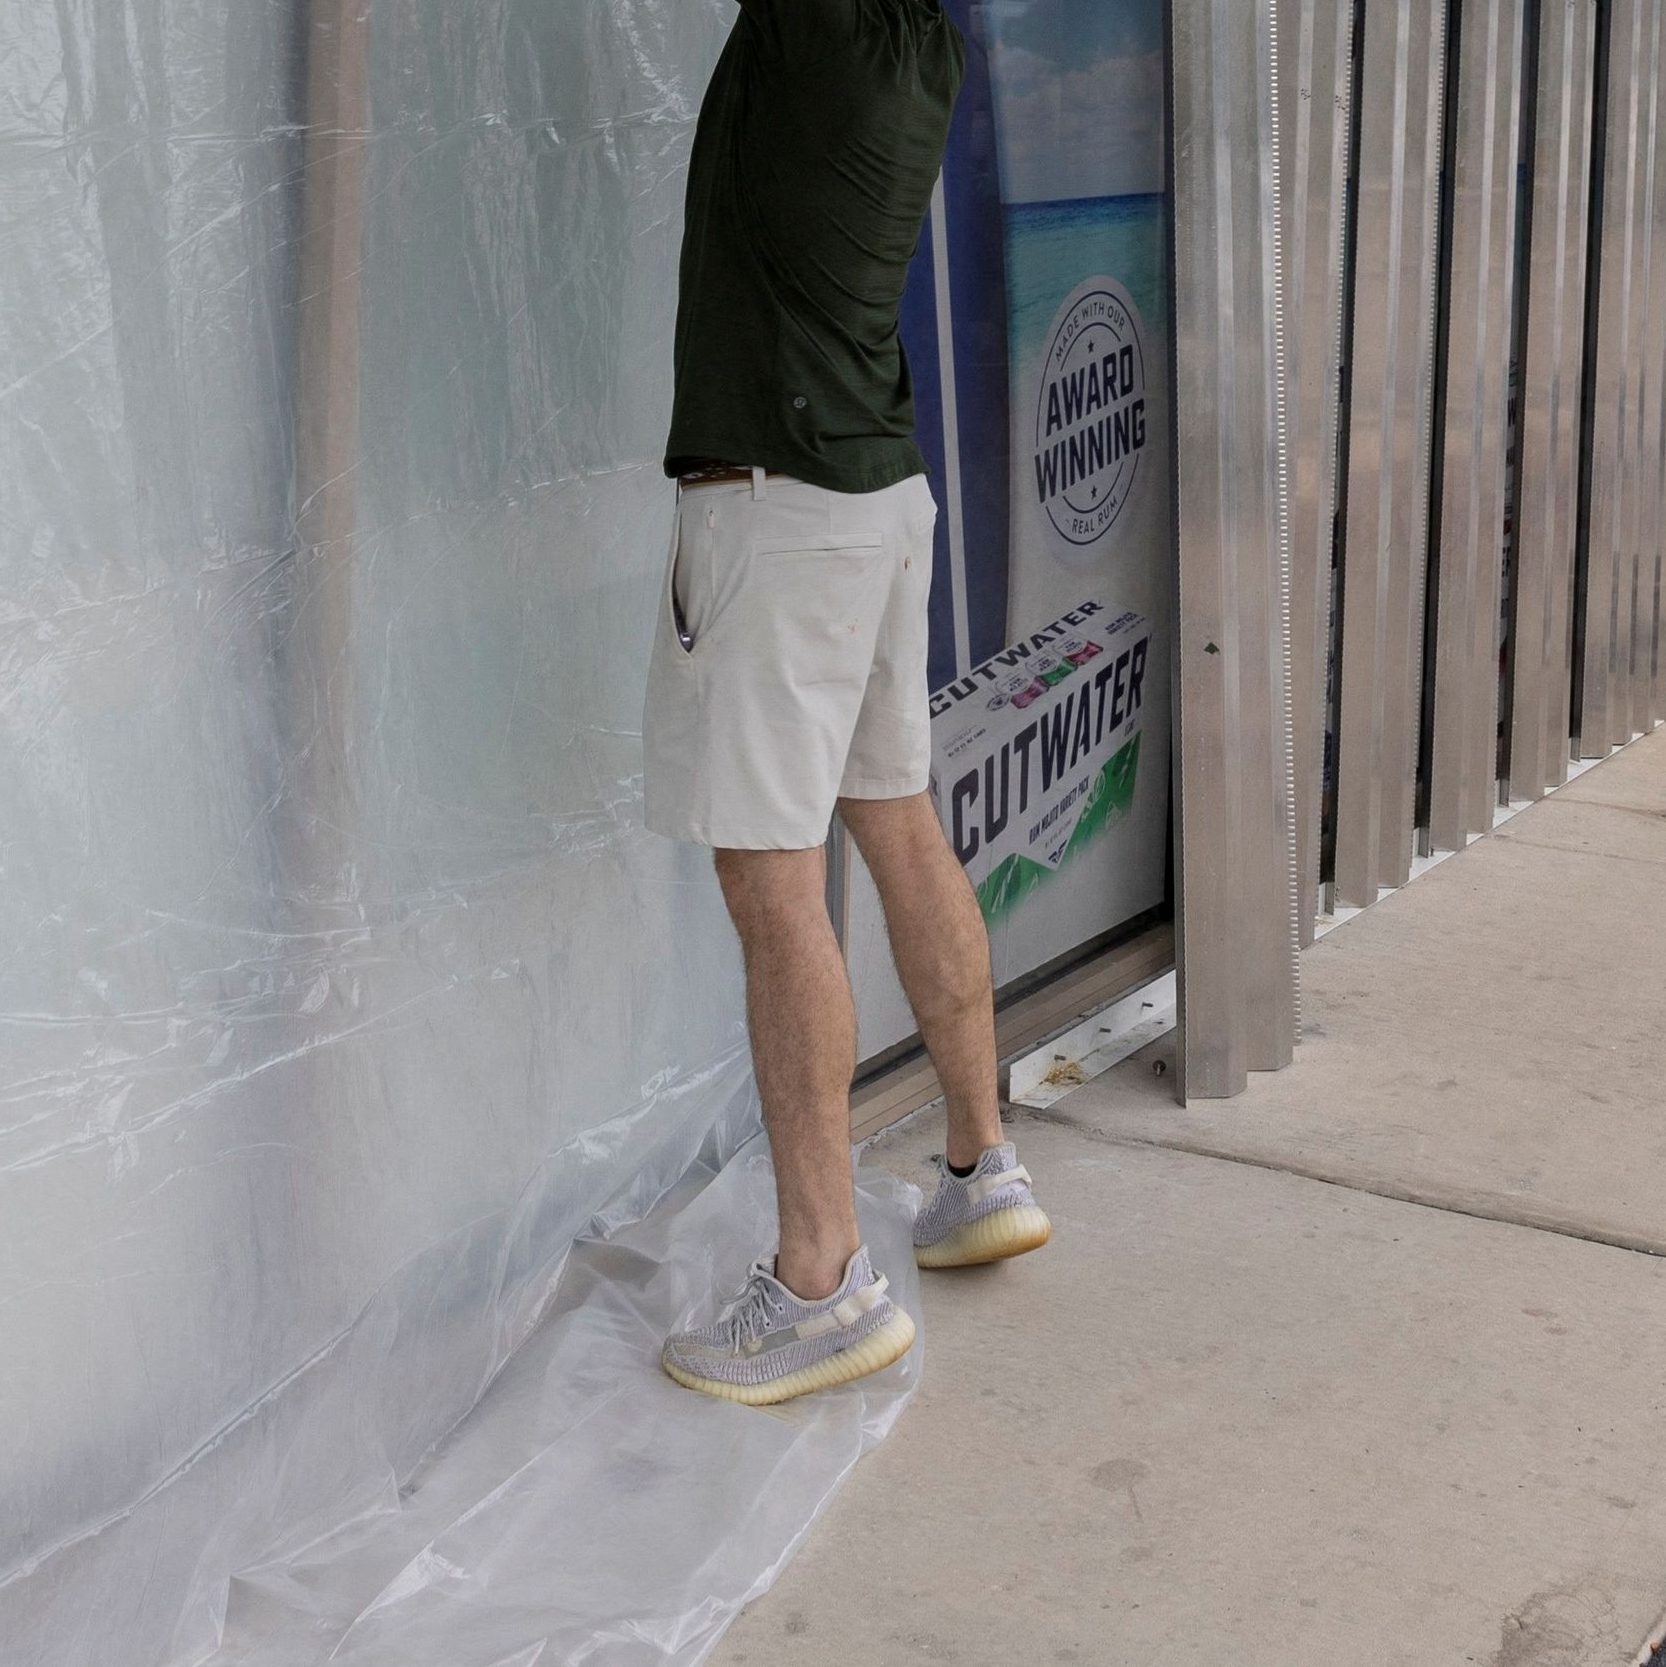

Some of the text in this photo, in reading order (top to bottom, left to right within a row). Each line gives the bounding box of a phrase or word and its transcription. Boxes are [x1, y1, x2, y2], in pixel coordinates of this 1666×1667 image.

[1055, 301, 1125, 362] MADE WITH OUR
[1046, 344, 1133, 438] AWARD
[1034, 398, 1145, 504] WINNING
[1072, 495, 1118, 535] REAL RUM
[930, 599, 1104, 720] CUTWATER
[951, 635, 1148, 867] CUTWATER
